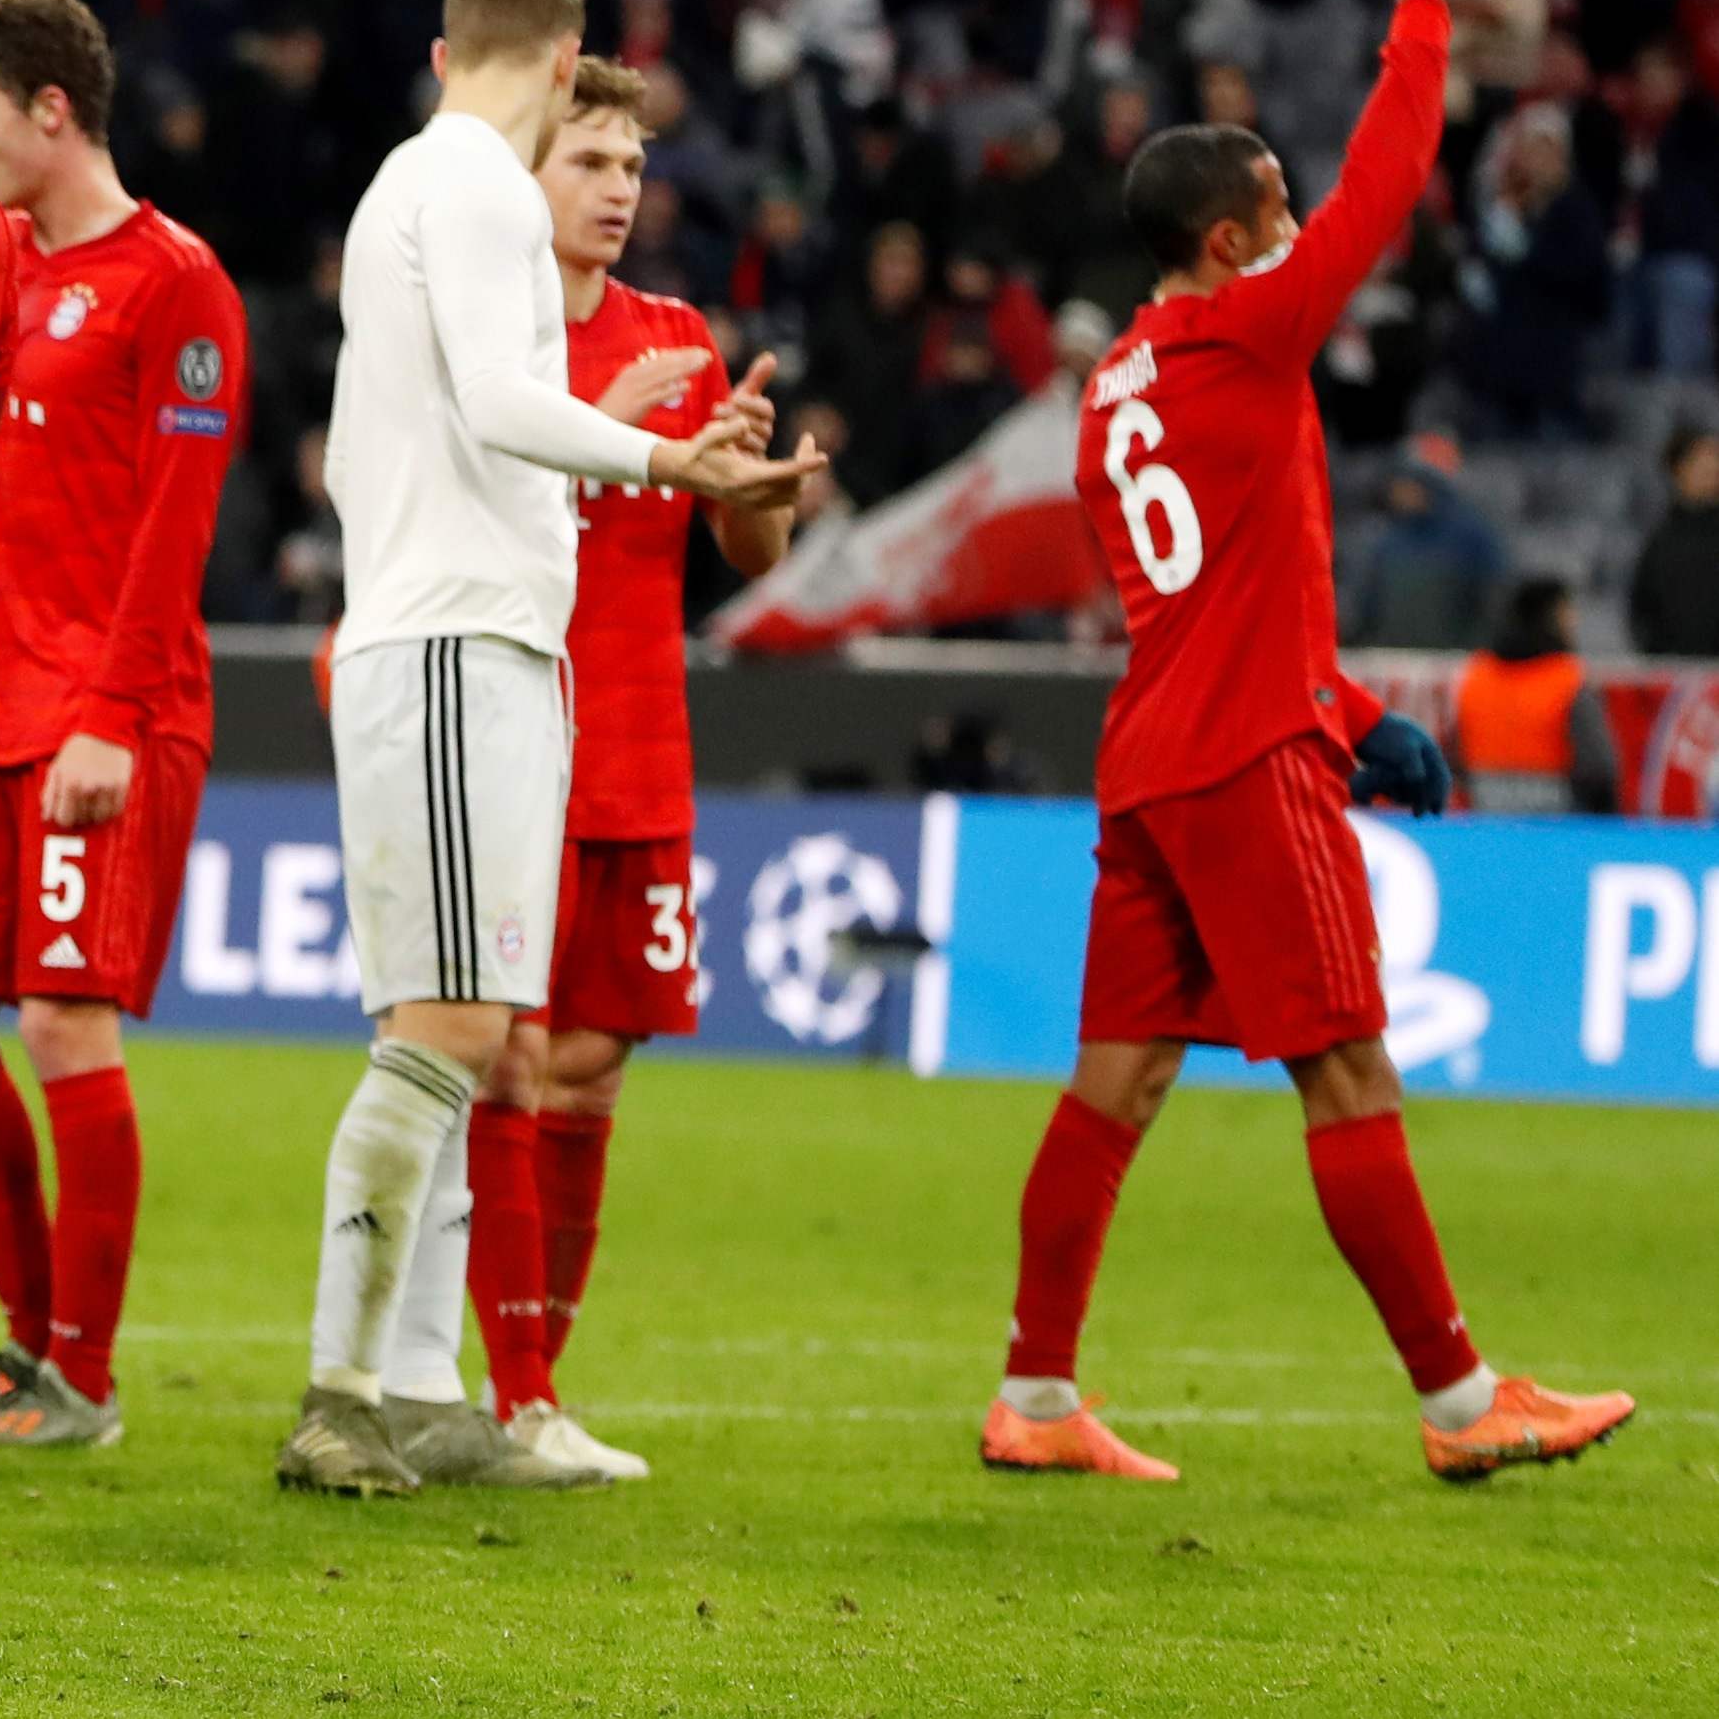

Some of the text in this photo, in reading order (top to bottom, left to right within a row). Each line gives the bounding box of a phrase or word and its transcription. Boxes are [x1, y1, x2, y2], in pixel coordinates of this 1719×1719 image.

[1104, 397, 1203, 596] 6
[38, 833, 87, 923] 5
[643, 883, 699, 973] 3
